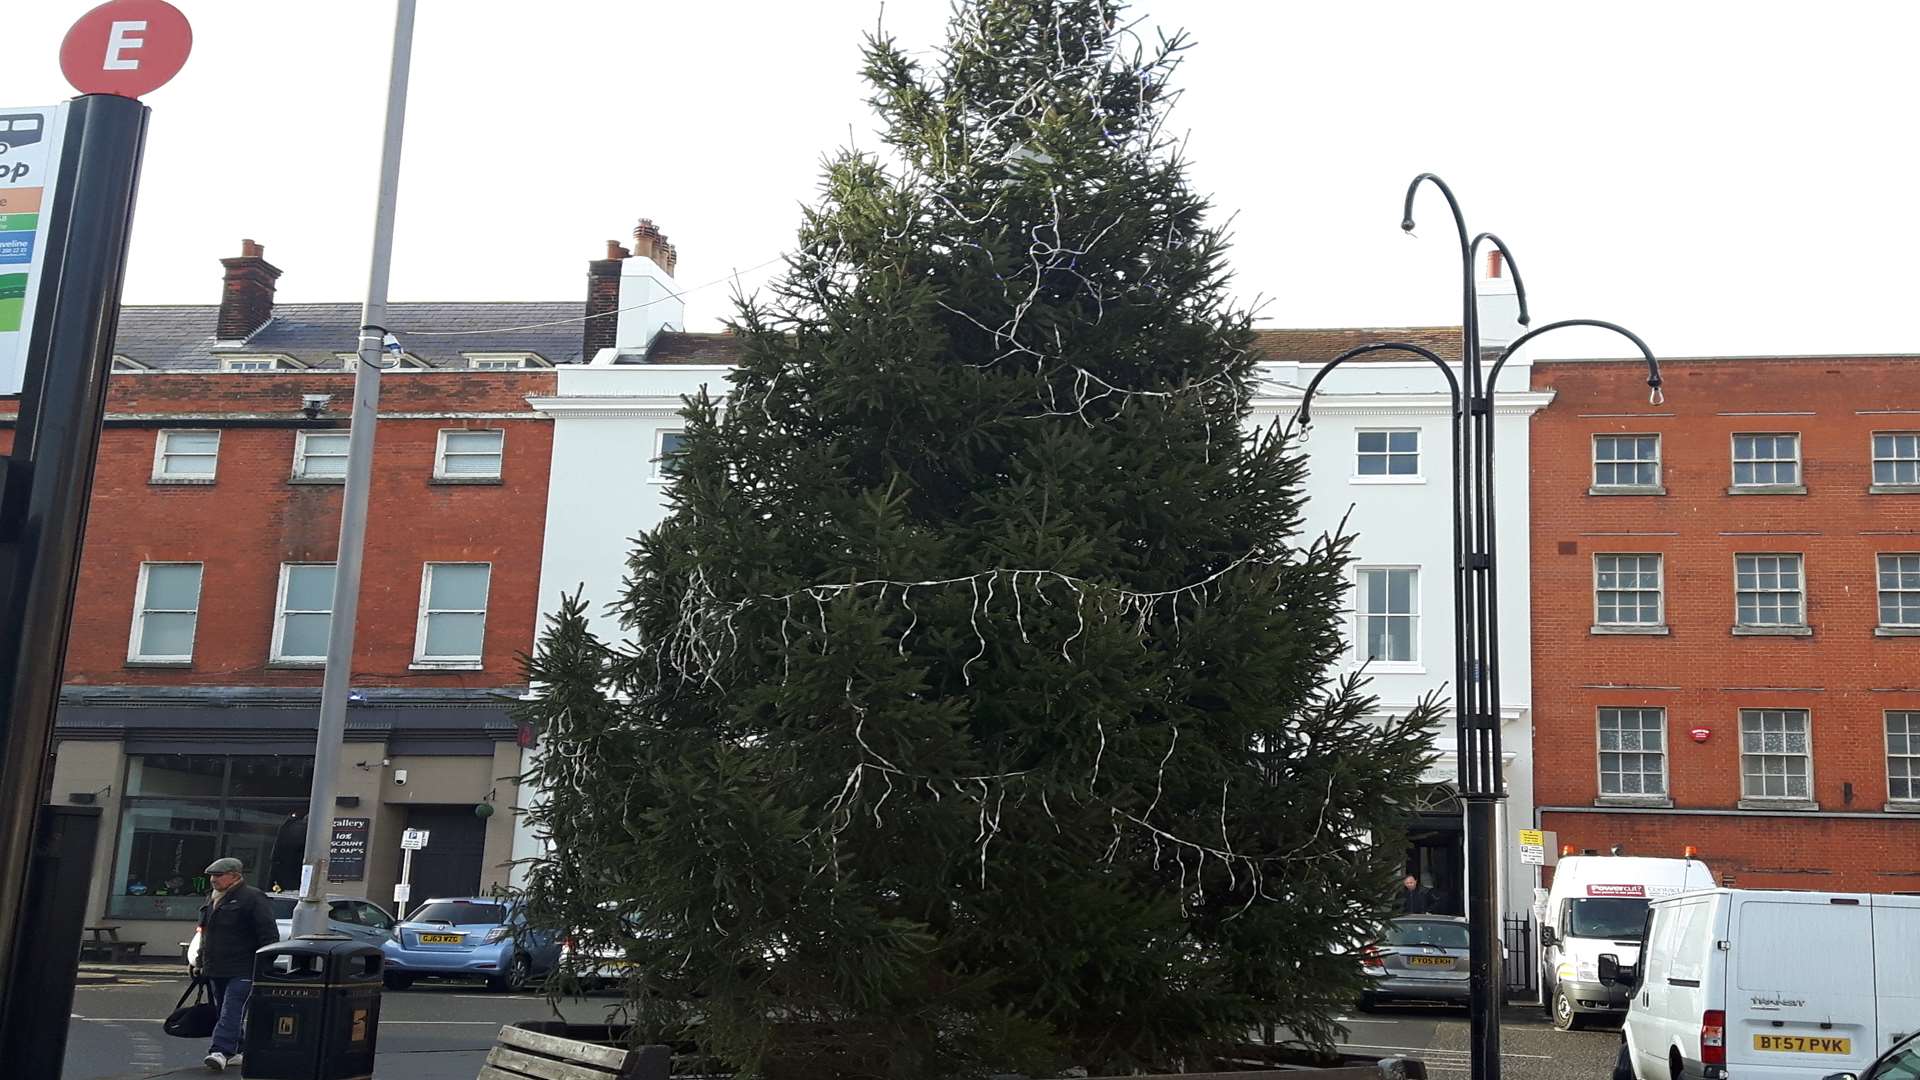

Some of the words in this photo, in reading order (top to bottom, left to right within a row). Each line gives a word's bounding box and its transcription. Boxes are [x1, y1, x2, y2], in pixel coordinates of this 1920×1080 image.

[103, 21, 147, 70] E
[1761, 1036, 1805, 1050] BT57
[1809, 1038, 1843, 1052] PVK
